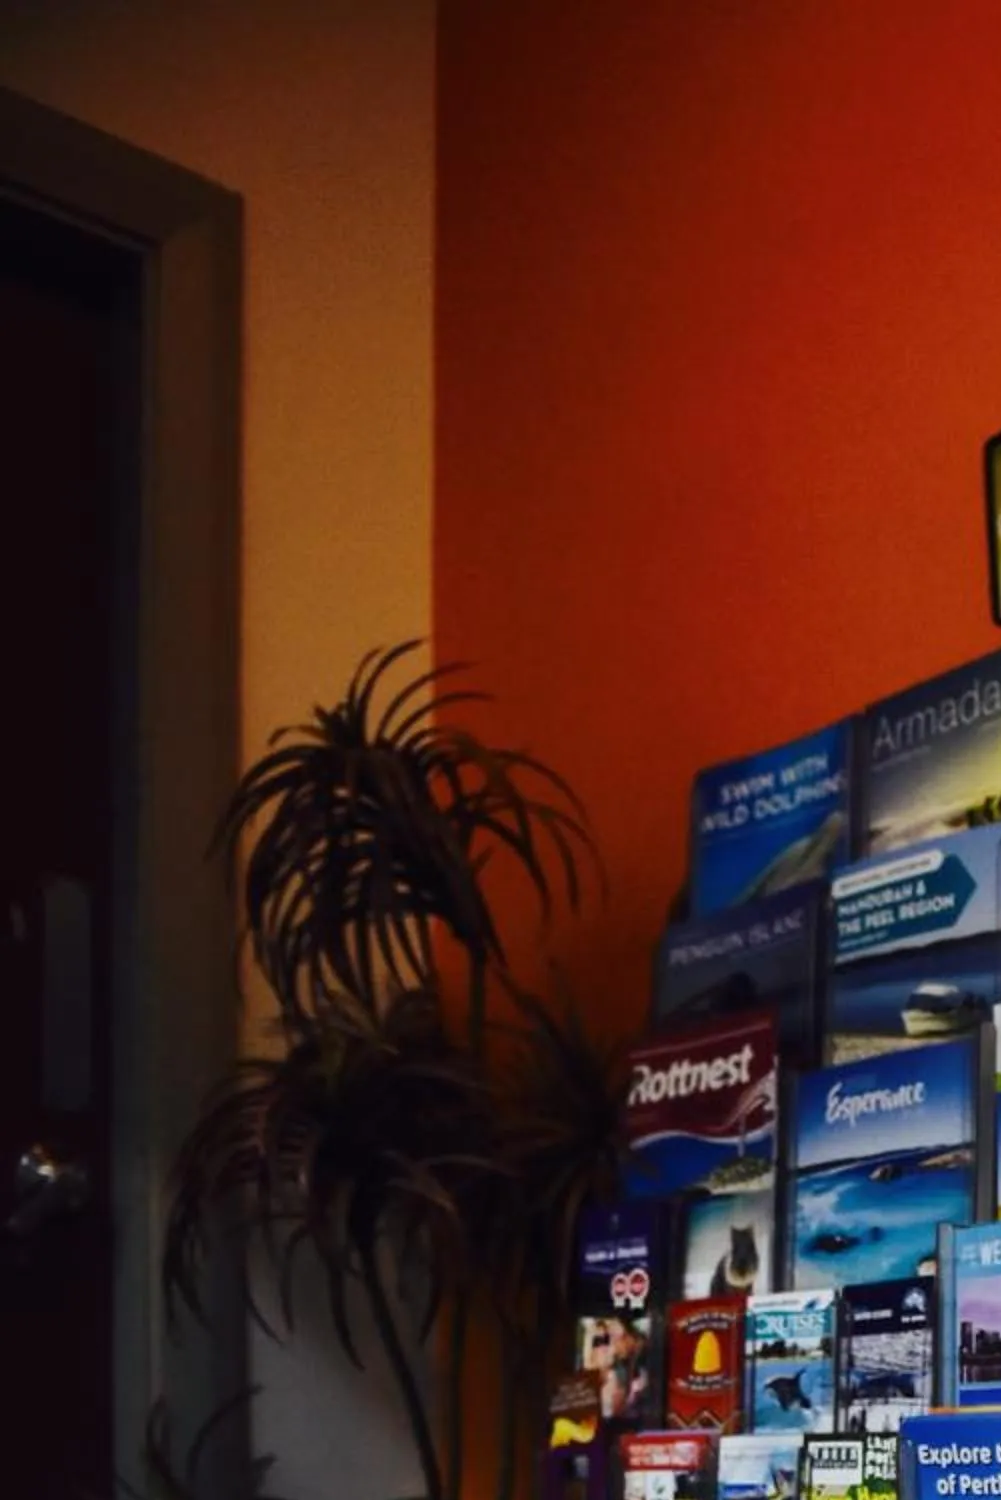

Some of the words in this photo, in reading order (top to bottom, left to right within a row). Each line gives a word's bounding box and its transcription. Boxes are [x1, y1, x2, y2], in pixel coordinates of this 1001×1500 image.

[627, 1043, 755, 1107] Rottnest
[918, 1444, 992, 1468] Explore
[936, 1473, 958, 1494] of
